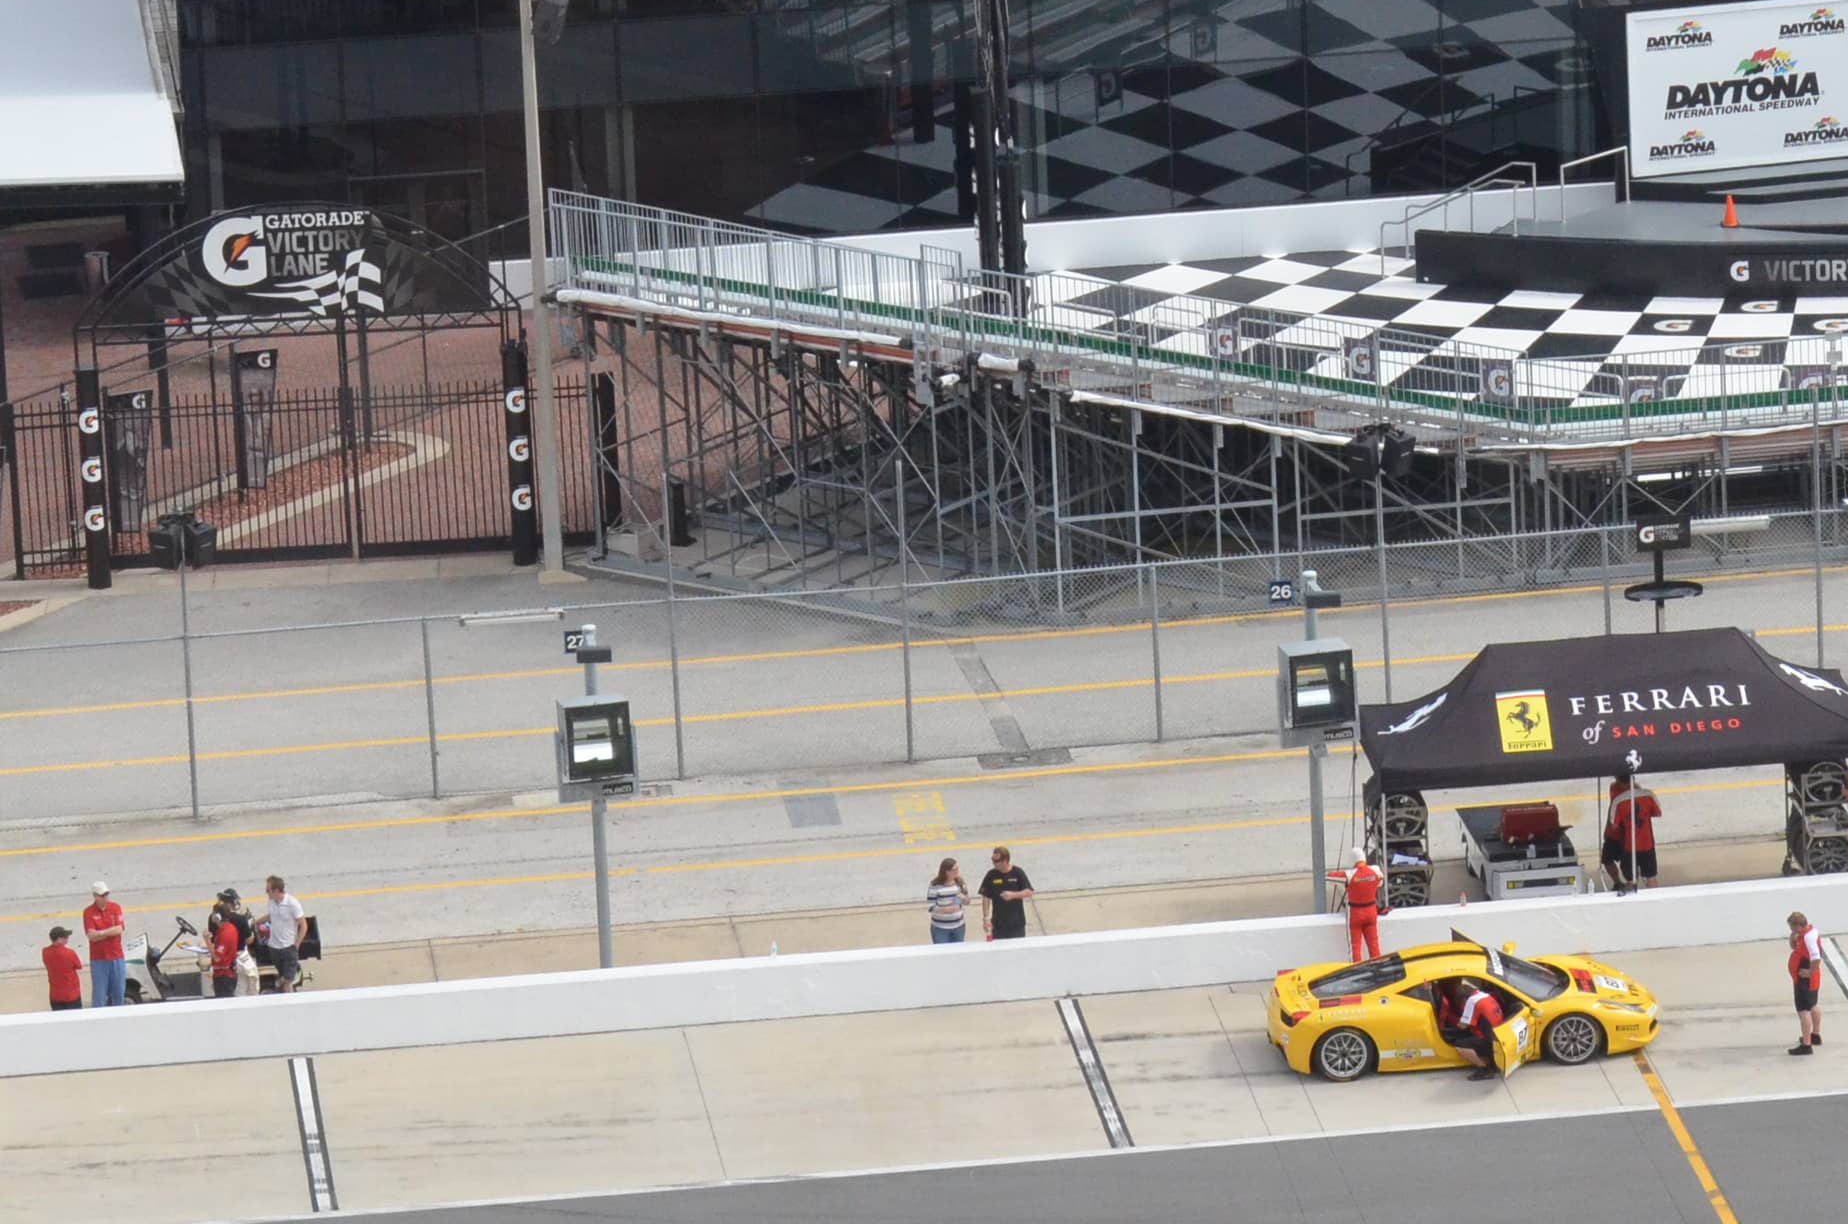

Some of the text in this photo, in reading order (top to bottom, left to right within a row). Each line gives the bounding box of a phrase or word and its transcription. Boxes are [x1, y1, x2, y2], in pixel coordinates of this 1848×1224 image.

[1779, 18, 1845, 36] DAYTONA
[1646, 31, 1713, 49] DAYTONA
[1665, 71, 1821, 111] DAYTONA
[1664, 97, 1821, 121] INTERNATIONAL SPEEDWAY
[1649, 140, 1715, 158] DAYTONA
[265, 210, 365, 229] GATORADE
[202, 215, 268, 287] G
[266, 229, 364, 253] VICTORY
[271, 253, 329, 277] LANE
[257, 352, 271, 368] G
[132, 394, 146, 409] G
[1271, 585, 1292, 599] 26
[1568, 684, 1752, 716] FERRARI
[1582, 717, 1742, 745] of SAN DIEGO
